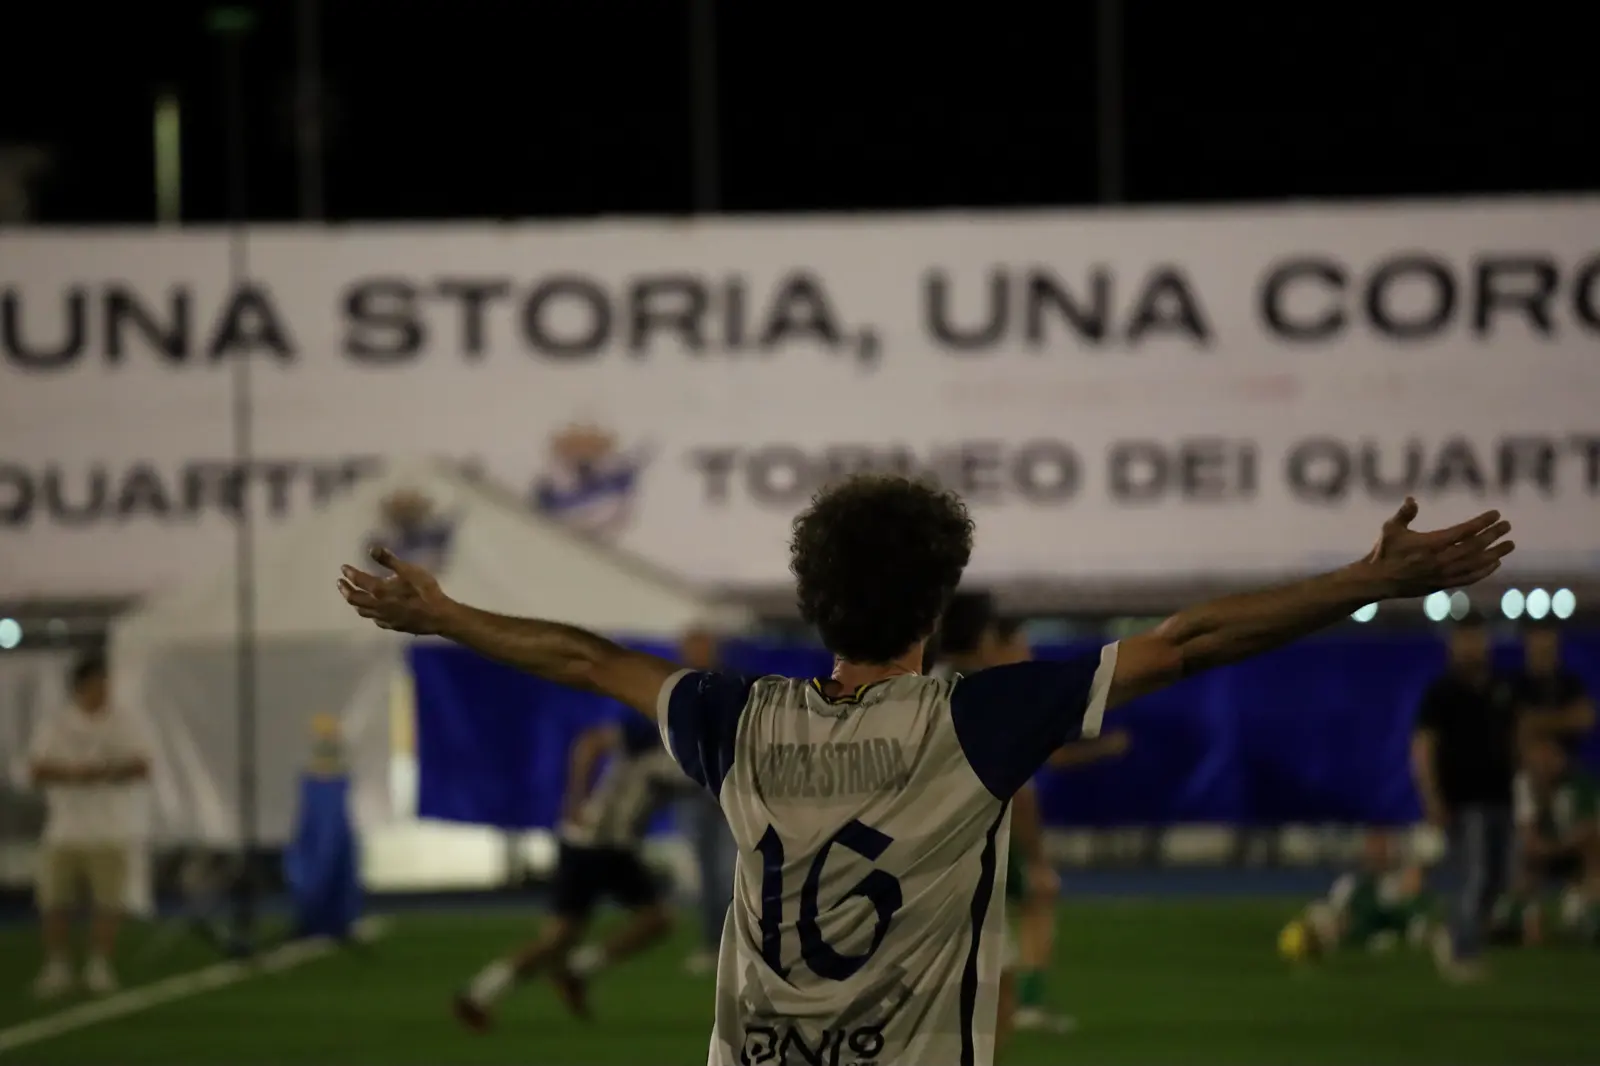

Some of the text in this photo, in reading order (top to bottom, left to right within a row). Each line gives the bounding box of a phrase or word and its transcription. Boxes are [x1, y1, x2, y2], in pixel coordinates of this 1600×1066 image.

[2, 281, 295, 368] UNA
[341, 274, 880, 368] STORIA,
[922, 265, 1213, 350] UNA
[1108, 437, 1258, 501] DEI
[753, 818, 903, 982] 16
